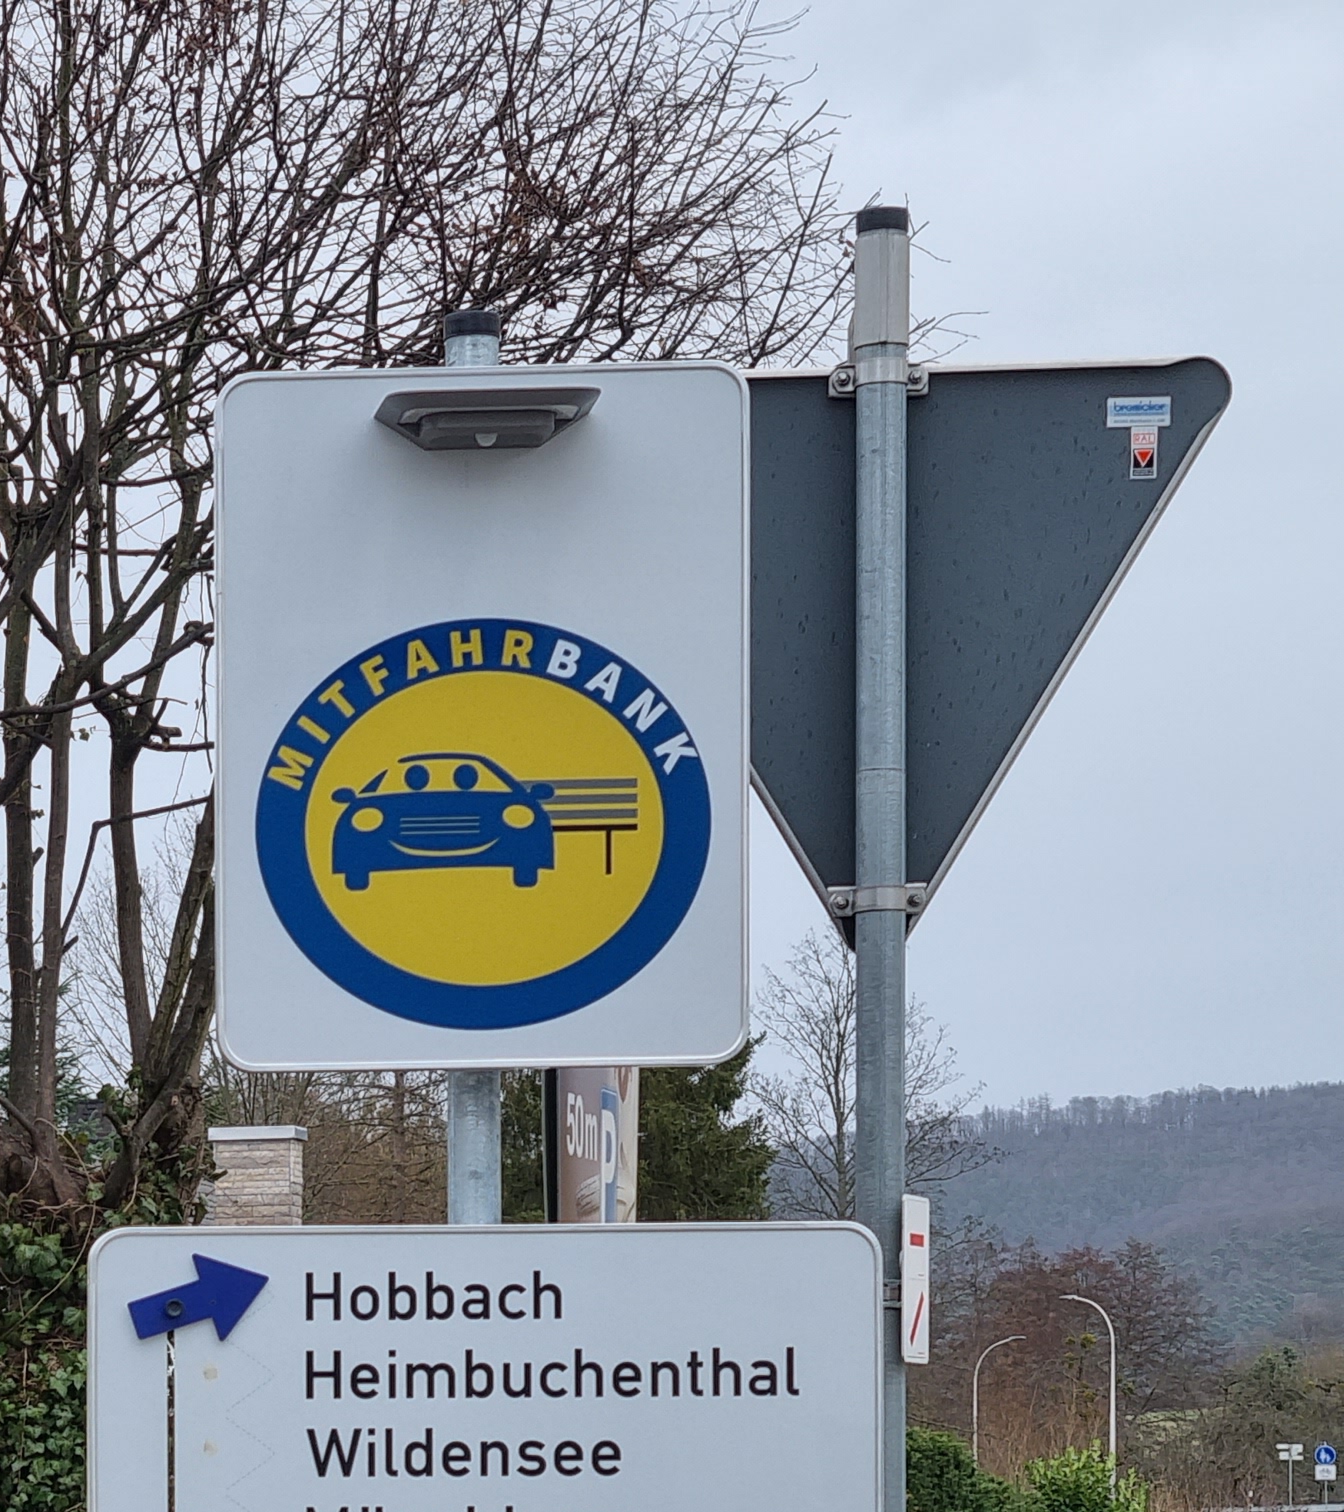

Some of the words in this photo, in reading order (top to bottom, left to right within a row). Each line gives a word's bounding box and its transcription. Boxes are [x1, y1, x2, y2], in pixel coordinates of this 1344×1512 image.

[267, 629, 698, 790] MITFAHRBANK
[305, 1271, 563, 1320] Hobbach
[305, 1347, 800, 1399] Heimbuchenthal
[306, 1428, 622, 1477] Wildensee
